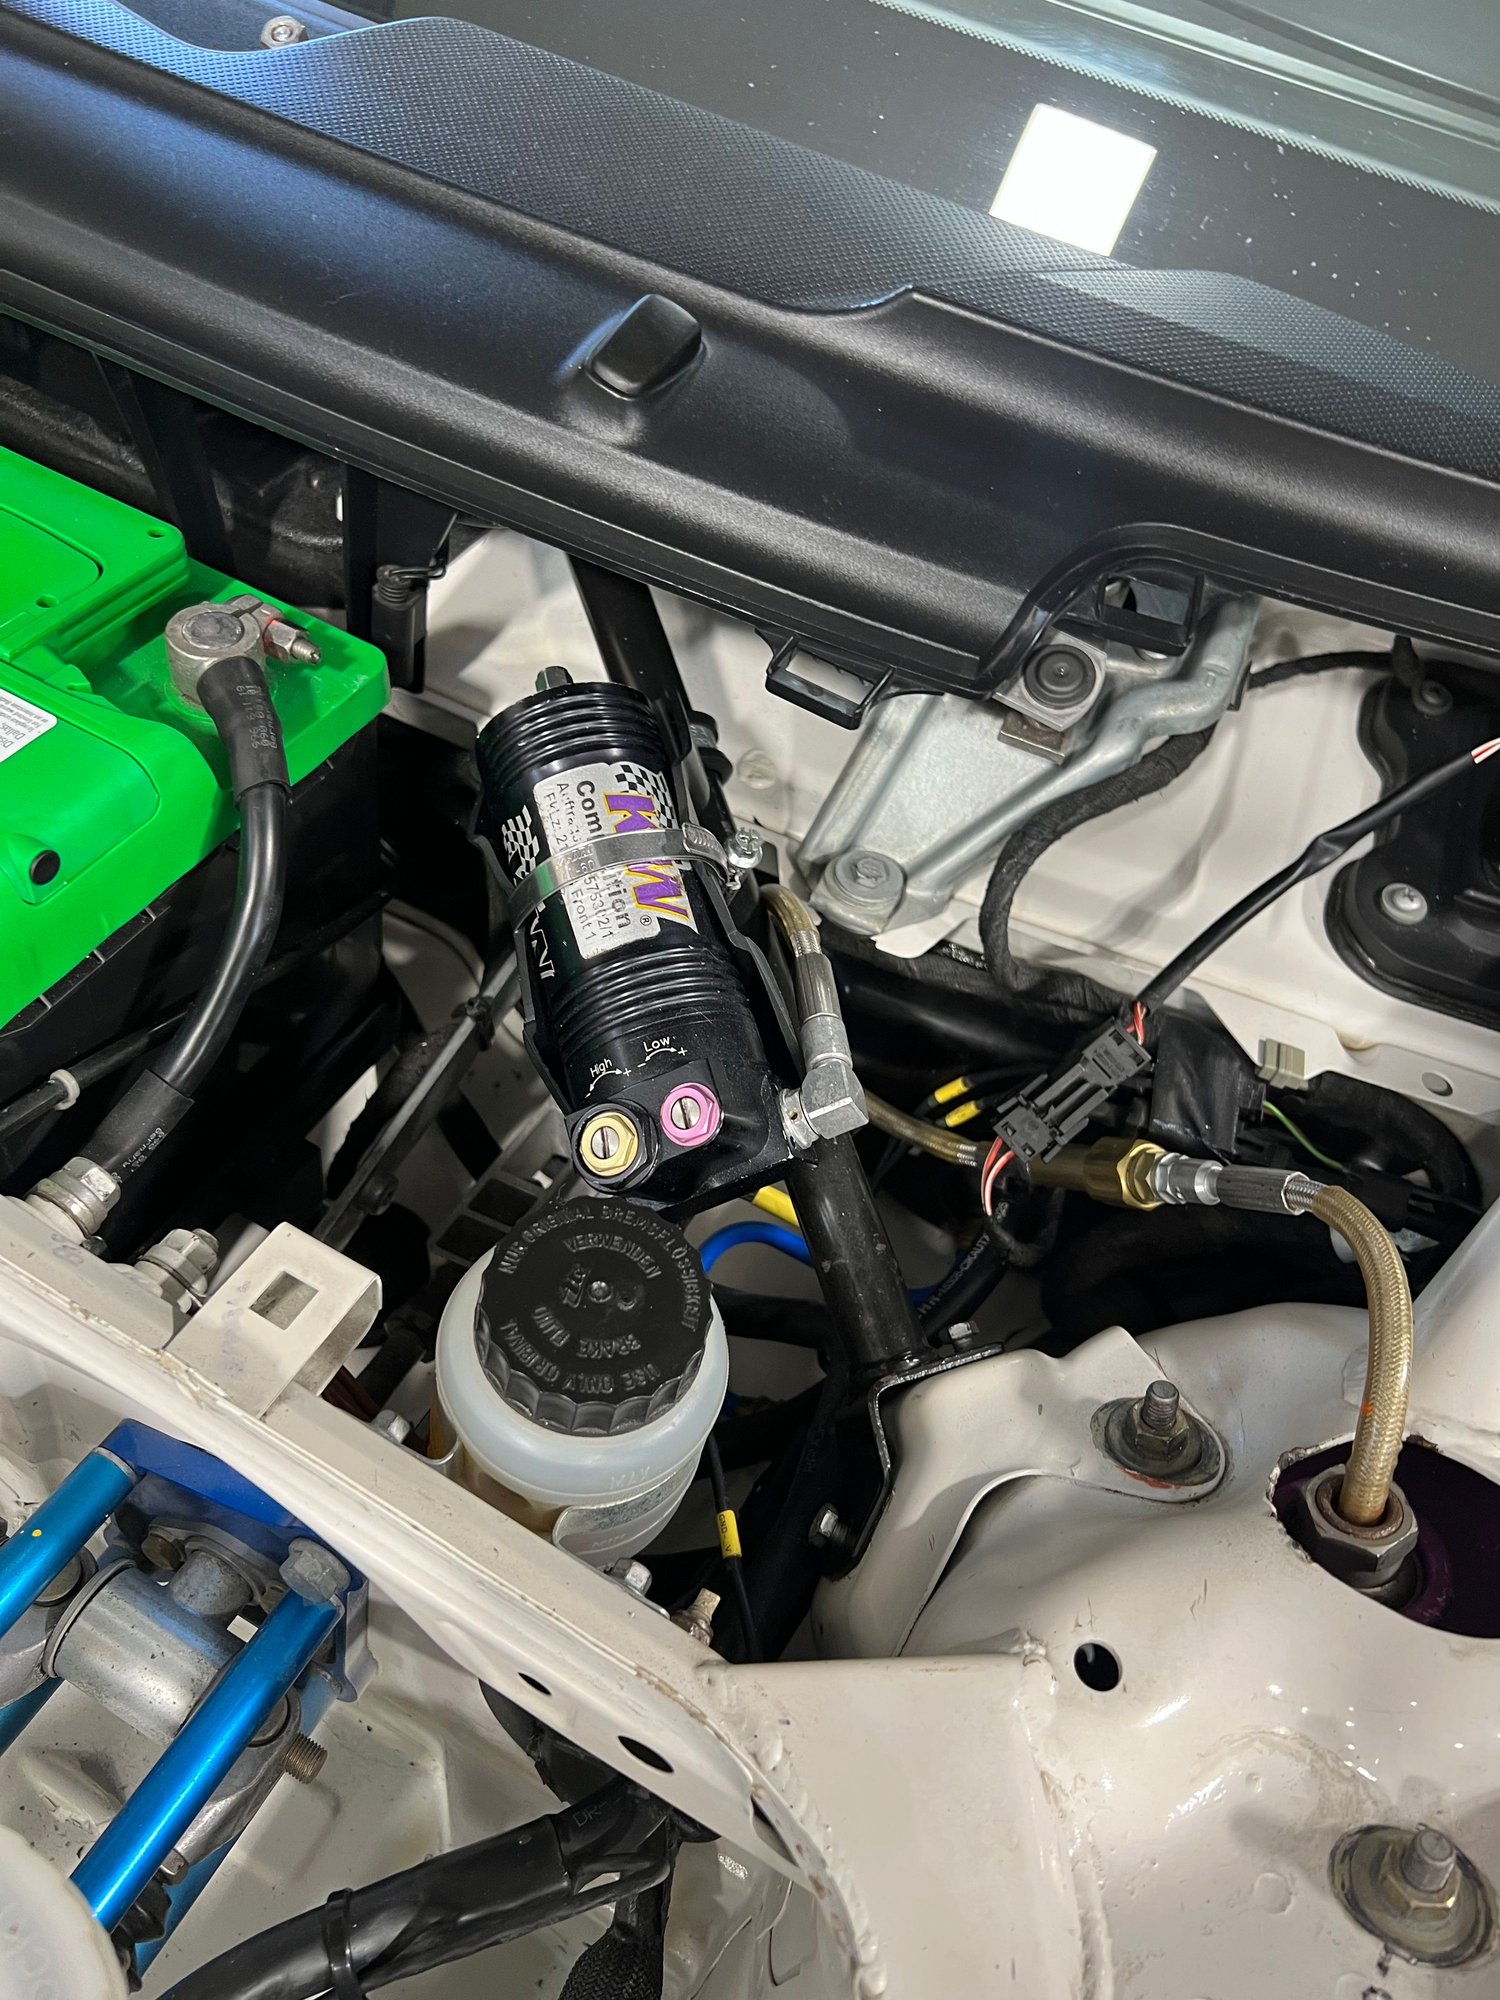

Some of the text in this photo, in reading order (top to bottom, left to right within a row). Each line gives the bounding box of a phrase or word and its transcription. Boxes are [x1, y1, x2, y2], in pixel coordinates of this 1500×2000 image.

[576, 779, 632, 930] Comition
[643, 1036, 670, 1053] Low
[590, 1058, 613, 1077] High
[563, 1233, 663, 1280] VERWENDEN
